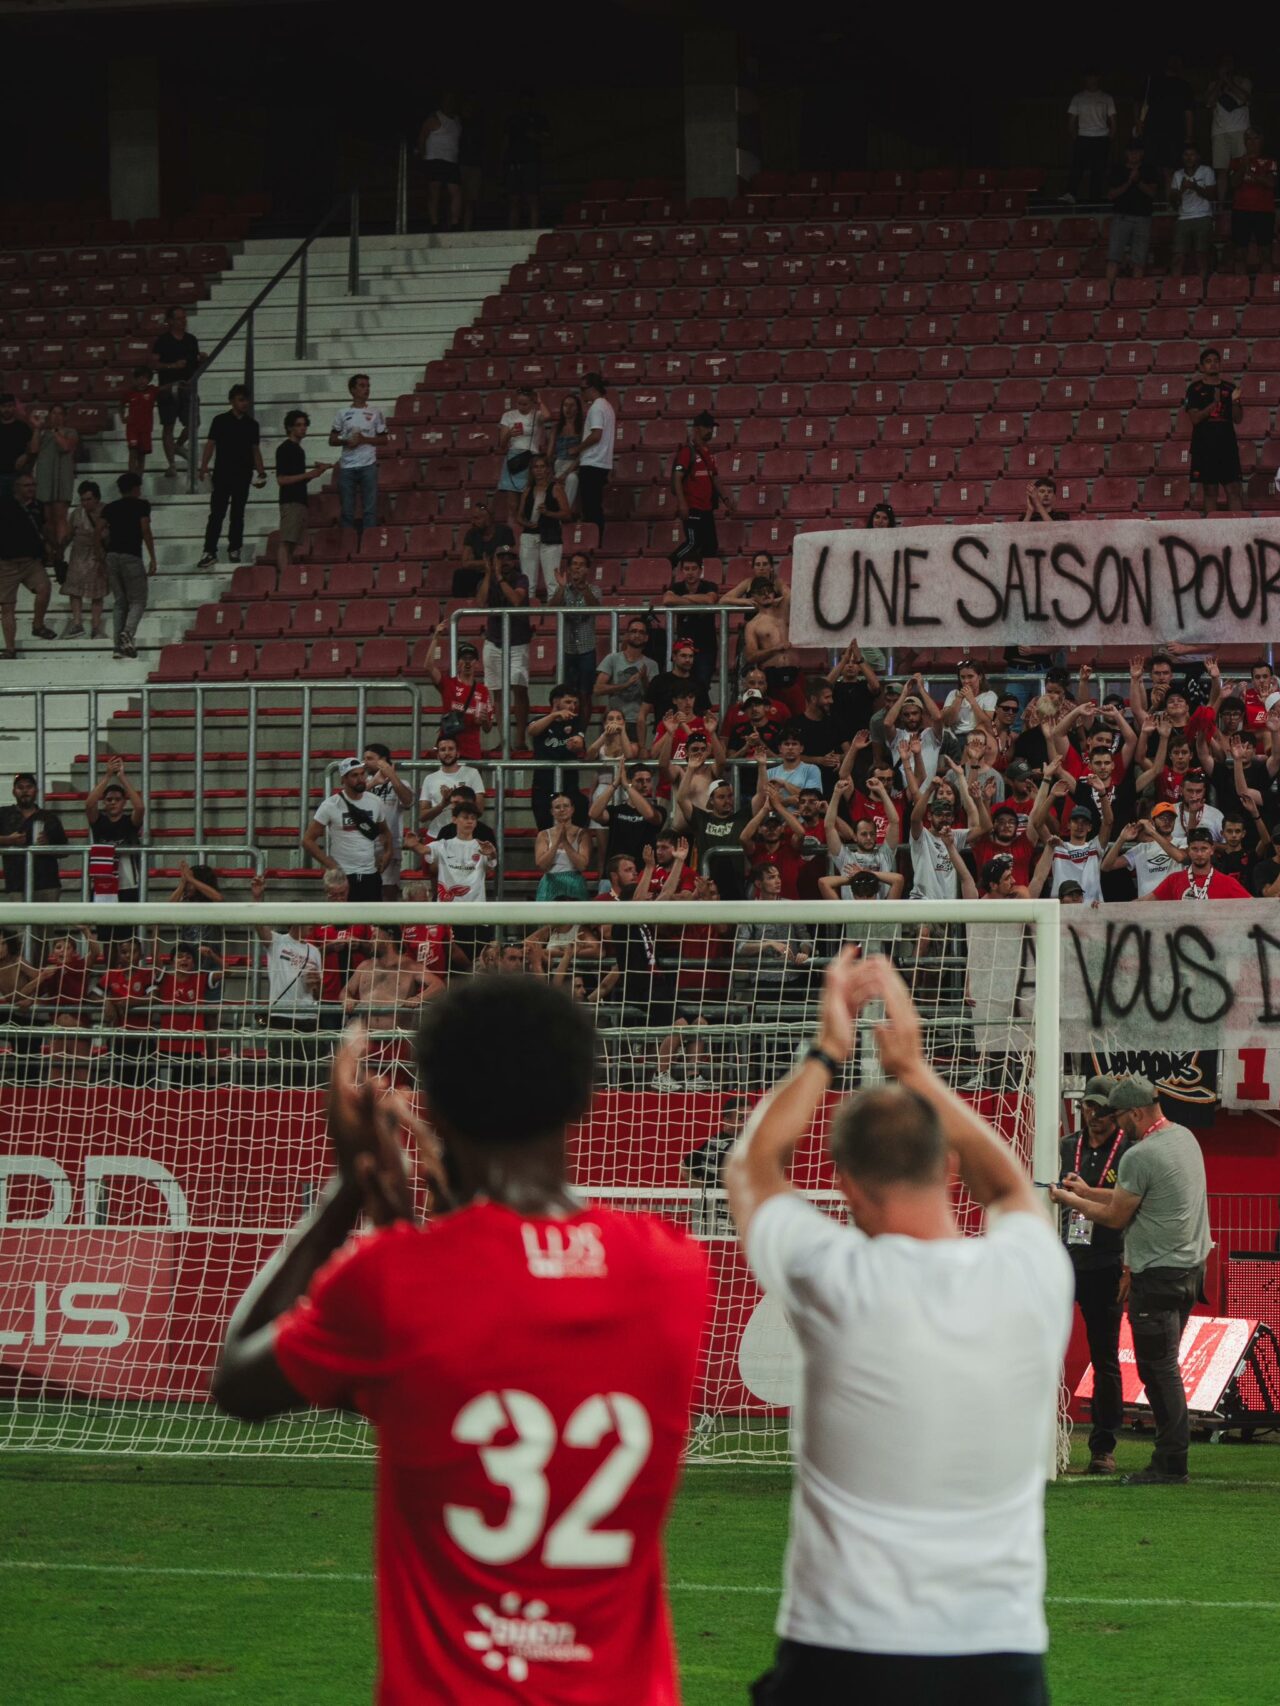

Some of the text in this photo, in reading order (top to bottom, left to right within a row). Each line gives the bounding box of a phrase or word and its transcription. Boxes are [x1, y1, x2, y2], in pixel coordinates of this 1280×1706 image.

[811, 546, 941, 632] UNE
[952, 536, 1152, 629] SAISON
[1067, 920, 1236, 1030] VOUS
[443, 1388, 653, 1570] 32
